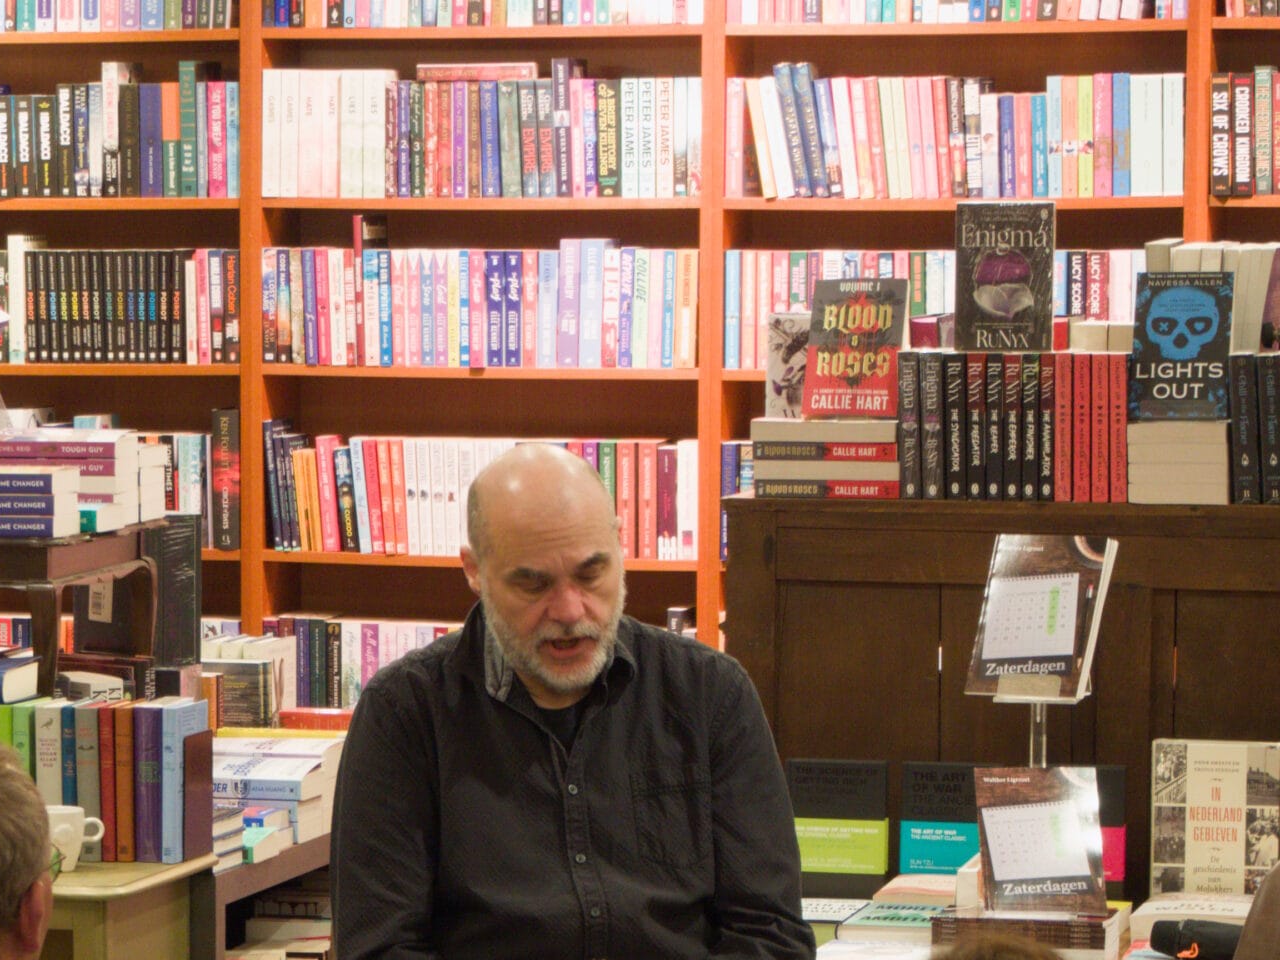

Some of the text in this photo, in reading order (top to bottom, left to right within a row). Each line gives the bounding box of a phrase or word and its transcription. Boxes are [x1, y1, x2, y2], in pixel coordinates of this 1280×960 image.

[60, 94, 70, 145] BALDACCI
[599, 83, 607, 175] OF SEVEN KILLINGS
[607, 99, 615, 126] BRIEF
[624, 81, 634, 168] PETER JAMES
[641, 81, 651, 168] PETER JAMES
[660, 81, 669, 165] PETER JAMES
[1213, 92, 1228, 176] SIX OF CROWS
[1235, 87, 1250, 182] CROOKED KINGDOM
[19, 114, 29, 162] BALDACCI
[41, 113, 51, 160] BALDACCI
[523, 128, 535, 173] EMPIRE
[540, 128, 552, 173] EMPIRE
[559, 128, 568, 150] QUEEN
[586, 142, 595, 176] ONLINE
[607, 128, 615, 170] HISTORY
[380, 254, 388, 268] BAD
[961, 223, 1049, 255] Enigma
[228, 255, 237, 314] Harlan Coben
[635, 258, 647, 303] COLLIDE
[1072, 255, 1082, 314] LUCY SCORE
[1091, 255, 1100, 314] LUCY SCORE
[1148, 279, 1190, 287] NAVESSA
[823, 303, 893, 334] BLOOD
[816, 351, 891, 378] ROSES
[900, 360, 918, 409] Enigma
[922, 361, 940, 410] Enigma
[1135, 362, 1224, 379] LIGHTS
[811, 394, 889, 411] CALLIE HART
[1152, 382, 1205, 400] OUT
[61, 446, 104, 454] TOUGH GUY
[220, 417, 229, 471] KEN FOLLETT
[832, 447, 877, 457] CALLIE HART
[949, 408, 960, 472] THE SYNDICATOR
[970, 408, 981, 466] THE PREDATOR
[990, 408, 999, 454] THE REAPER
[1007, 409, 1017, 461] THE EMPEROR
[1025, 409, 1035, 461] THE FINISHER
[1041, 409, 1052, 477] THE ANNIHILATOR
[89, 464, 104, 472] GUY
[834, 485, 879, 496] CALLIE HART
[984, 659, 1067, 677] Zaterdagen
[912, 783, 962, 793] OF WAR
[913, 771, 967, 782] THE ART
[1211, 786, 1221, 801] IN
[1189, 807, 1242, 822] NEDERLAND
[1193, 826, 1238, 842] GEBLEVEN
[1002, 880, 1089, 896] Zaterdagen
